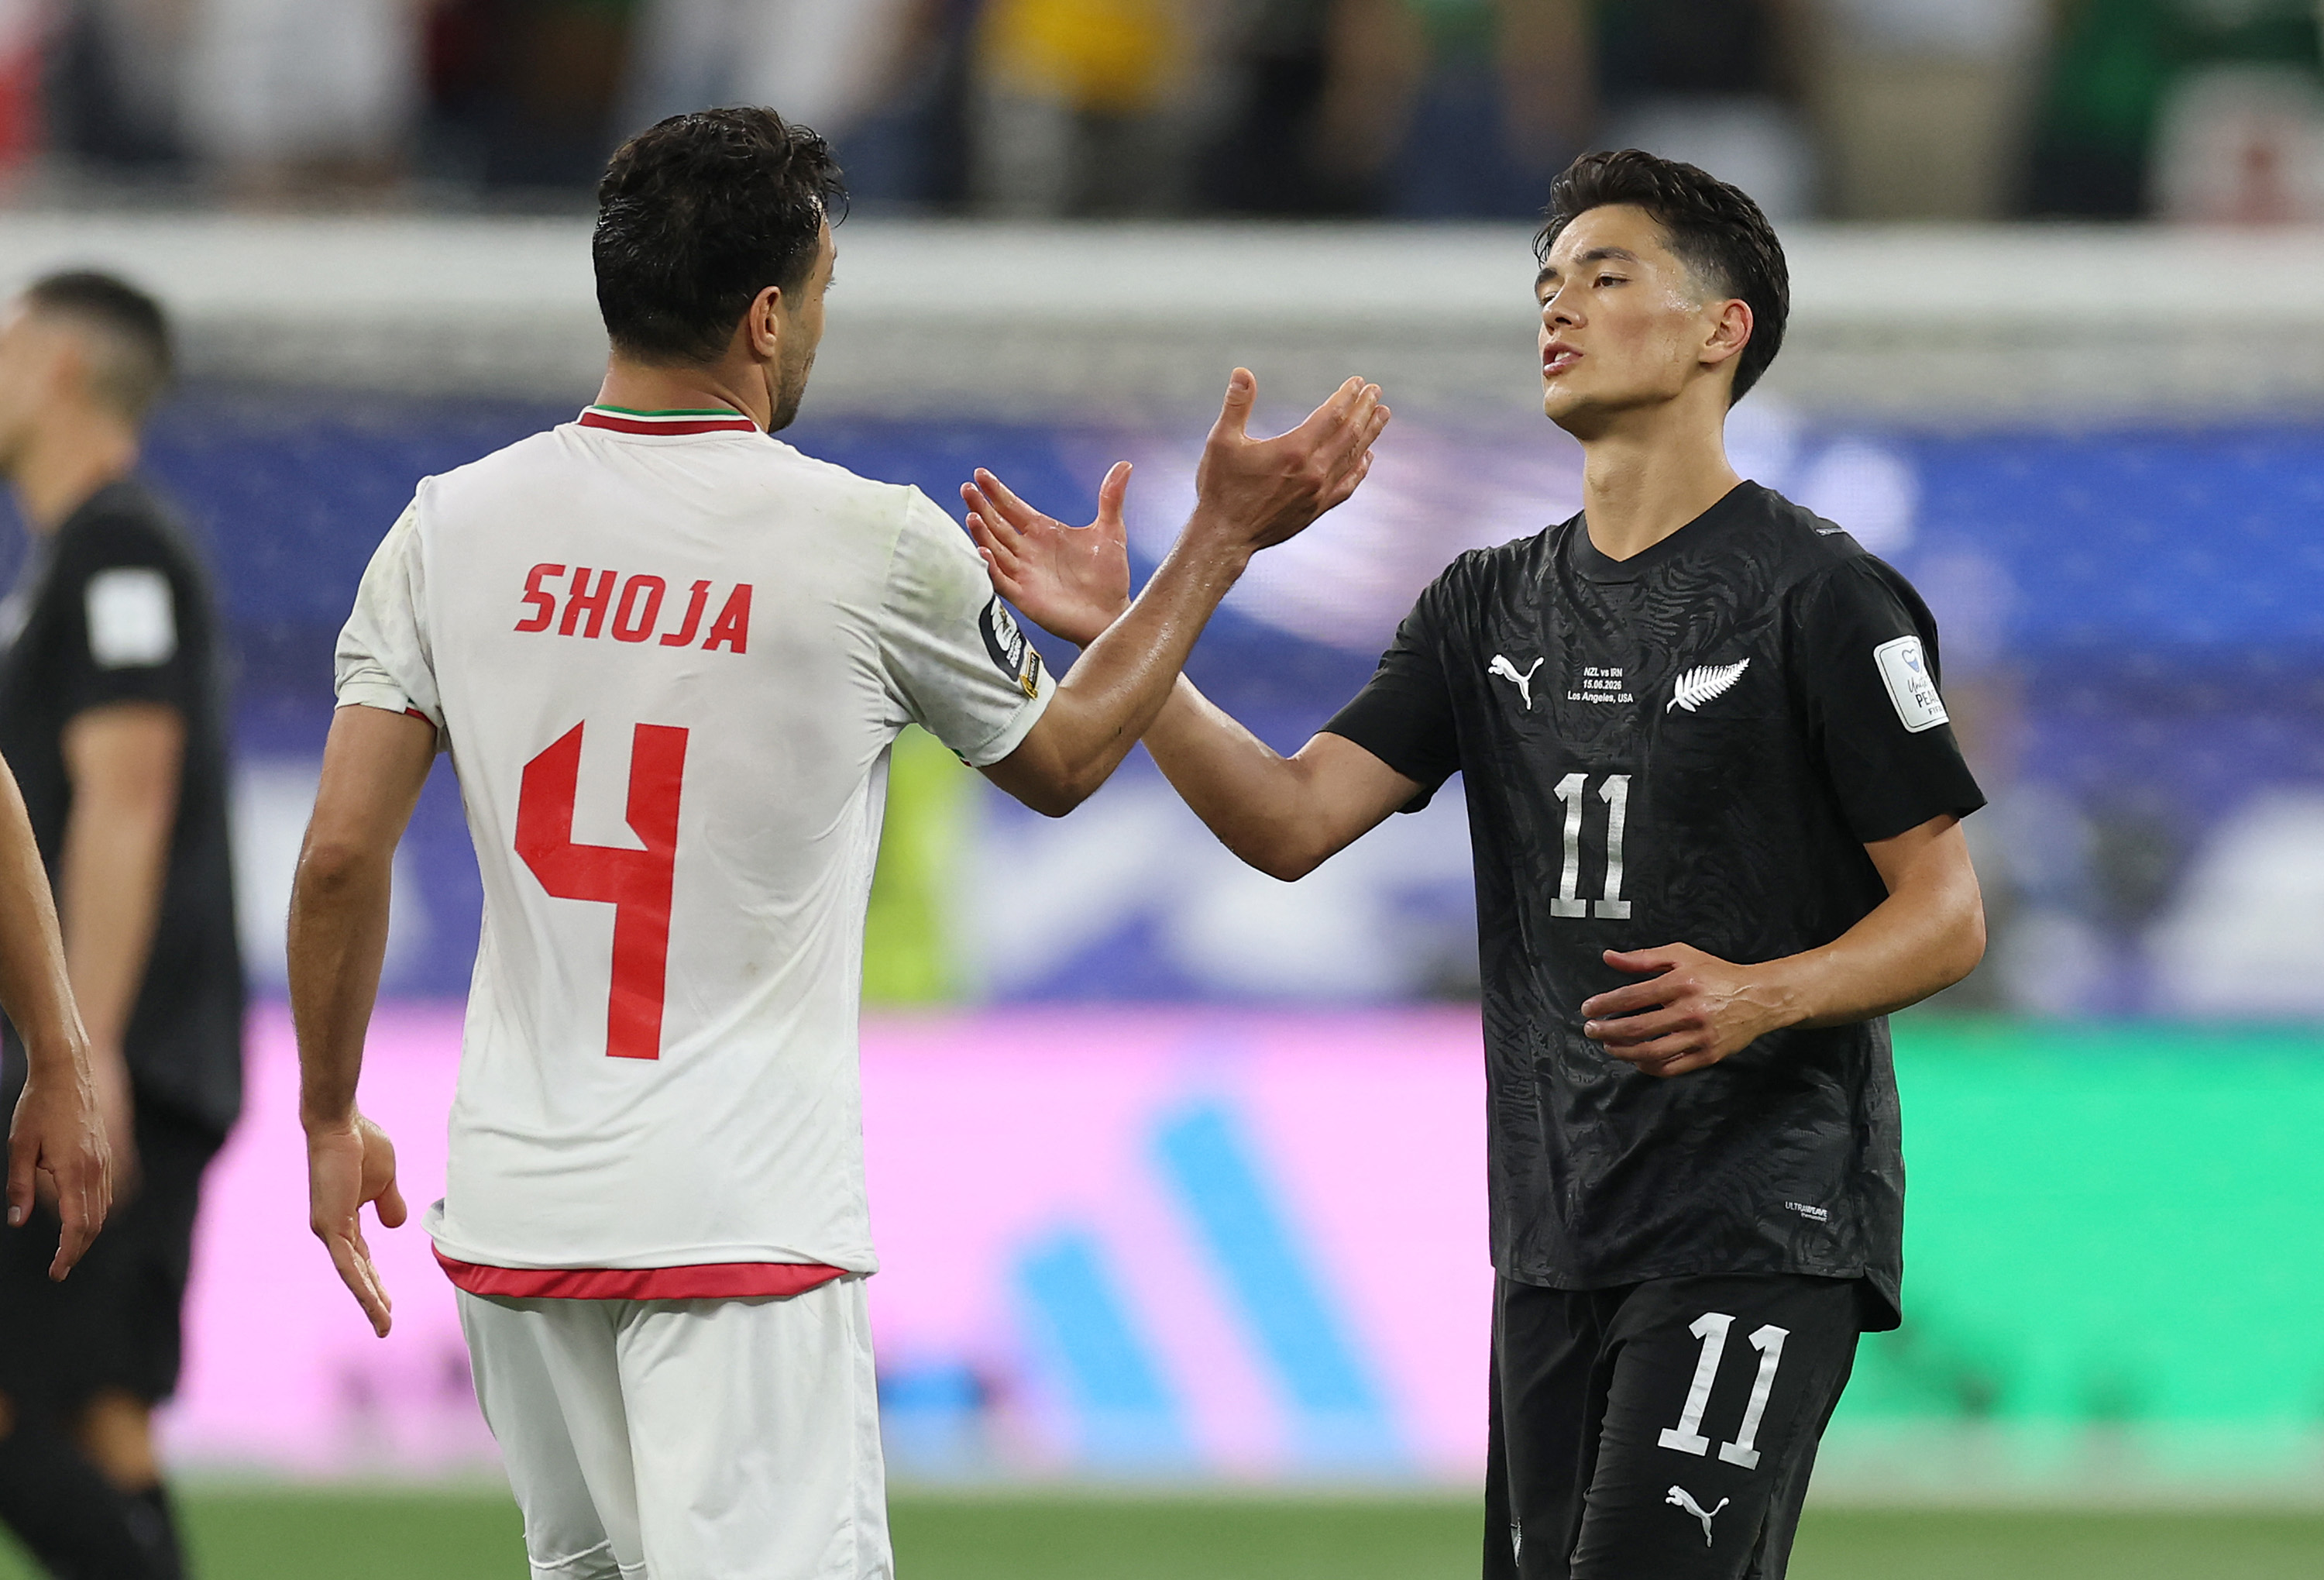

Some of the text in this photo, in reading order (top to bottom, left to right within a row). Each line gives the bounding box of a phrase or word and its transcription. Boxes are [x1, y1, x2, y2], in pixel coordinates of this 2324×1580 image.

[514, 563, 752, 654] SHOJA
[1568, 690, 1633, 704] Los Angeles, USA
[1583, 667, 1599, 676] NZL
[1611, 668, 1622, 676] IRN
[1583, 680, 1621, 690] 15.06.2026
[1916, 689, 1939, 708] PEAC
[1551, 773, 1632, 919] 11
[514, 719, 689, 1060] 4
[1657, 1312, 1790, 1470] 11
